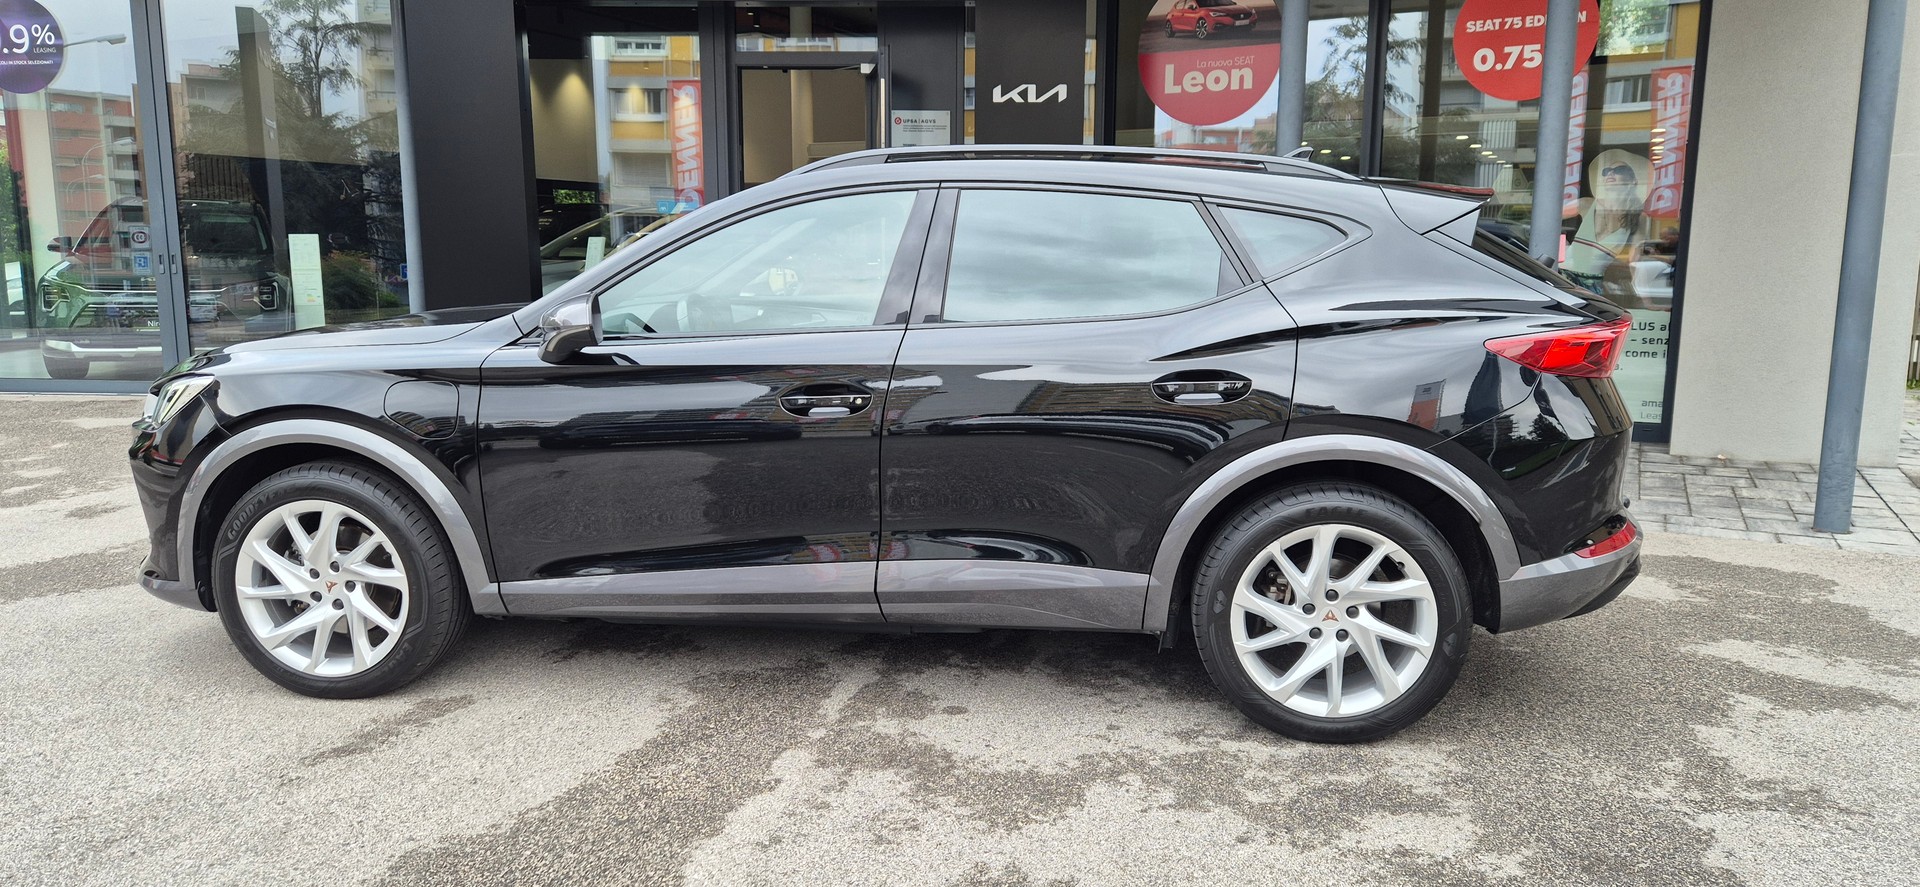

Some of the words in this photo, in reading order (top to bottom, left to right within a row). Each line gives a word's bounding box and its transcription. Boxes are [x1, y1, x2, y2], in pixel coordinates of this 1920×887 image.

[1466, 19, 1502, 32] SEAT
[1504, 16, 1522, 29] 75
[0, 24, 55, 54] .9%
[1196, 59, 1206, 68] La
[1208, 59, 1233, 67] nuova
[1234, 55, 1255, 66] SEAT
[1473, 44, 1543, 72] 0.75
[1164, 64, 1253, 94] Leon
[992, 84, 1068, 103] KIA
[1631, 322, 1655, 331] LUS
[1642, 337, 1669, 345] senz
[1625, 350, 1658, 359] come
[1640, 411, 1662, 420] Leas
